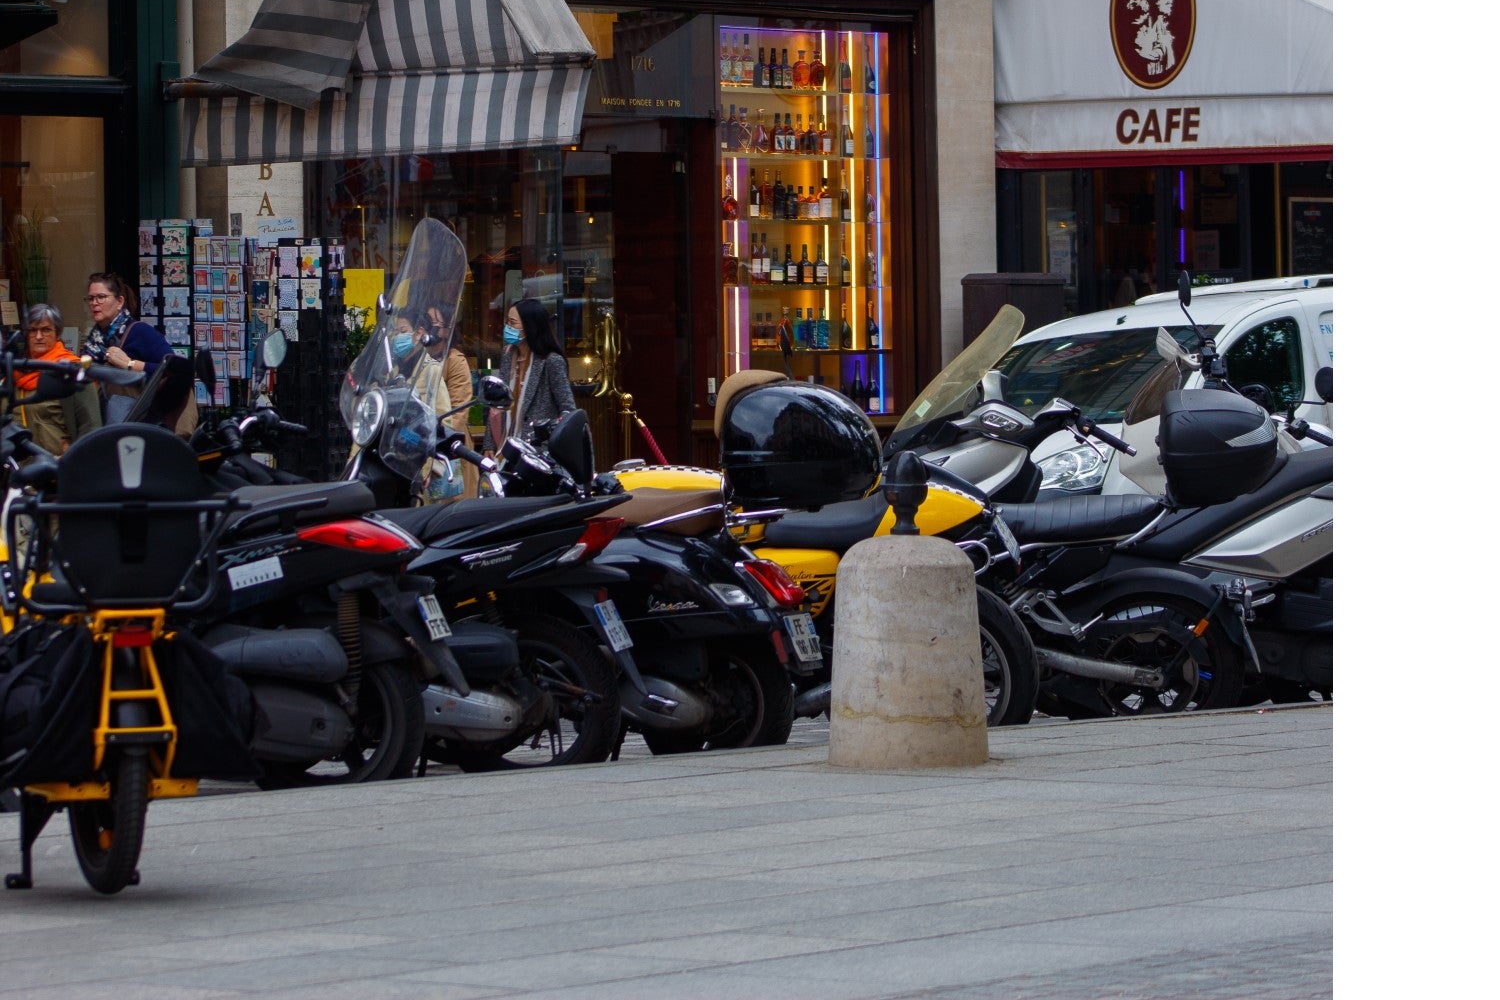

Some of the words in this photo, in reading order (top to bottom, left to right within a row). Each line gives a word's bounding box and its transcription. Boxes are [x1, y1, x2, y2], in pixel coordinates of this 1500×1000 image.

[601, 97, 625, 106] MAISON
[656, 99, 664, 107] EN
[668, 99, 681, 108] 1716
[1115, 107, 1201, 145] CAFE
